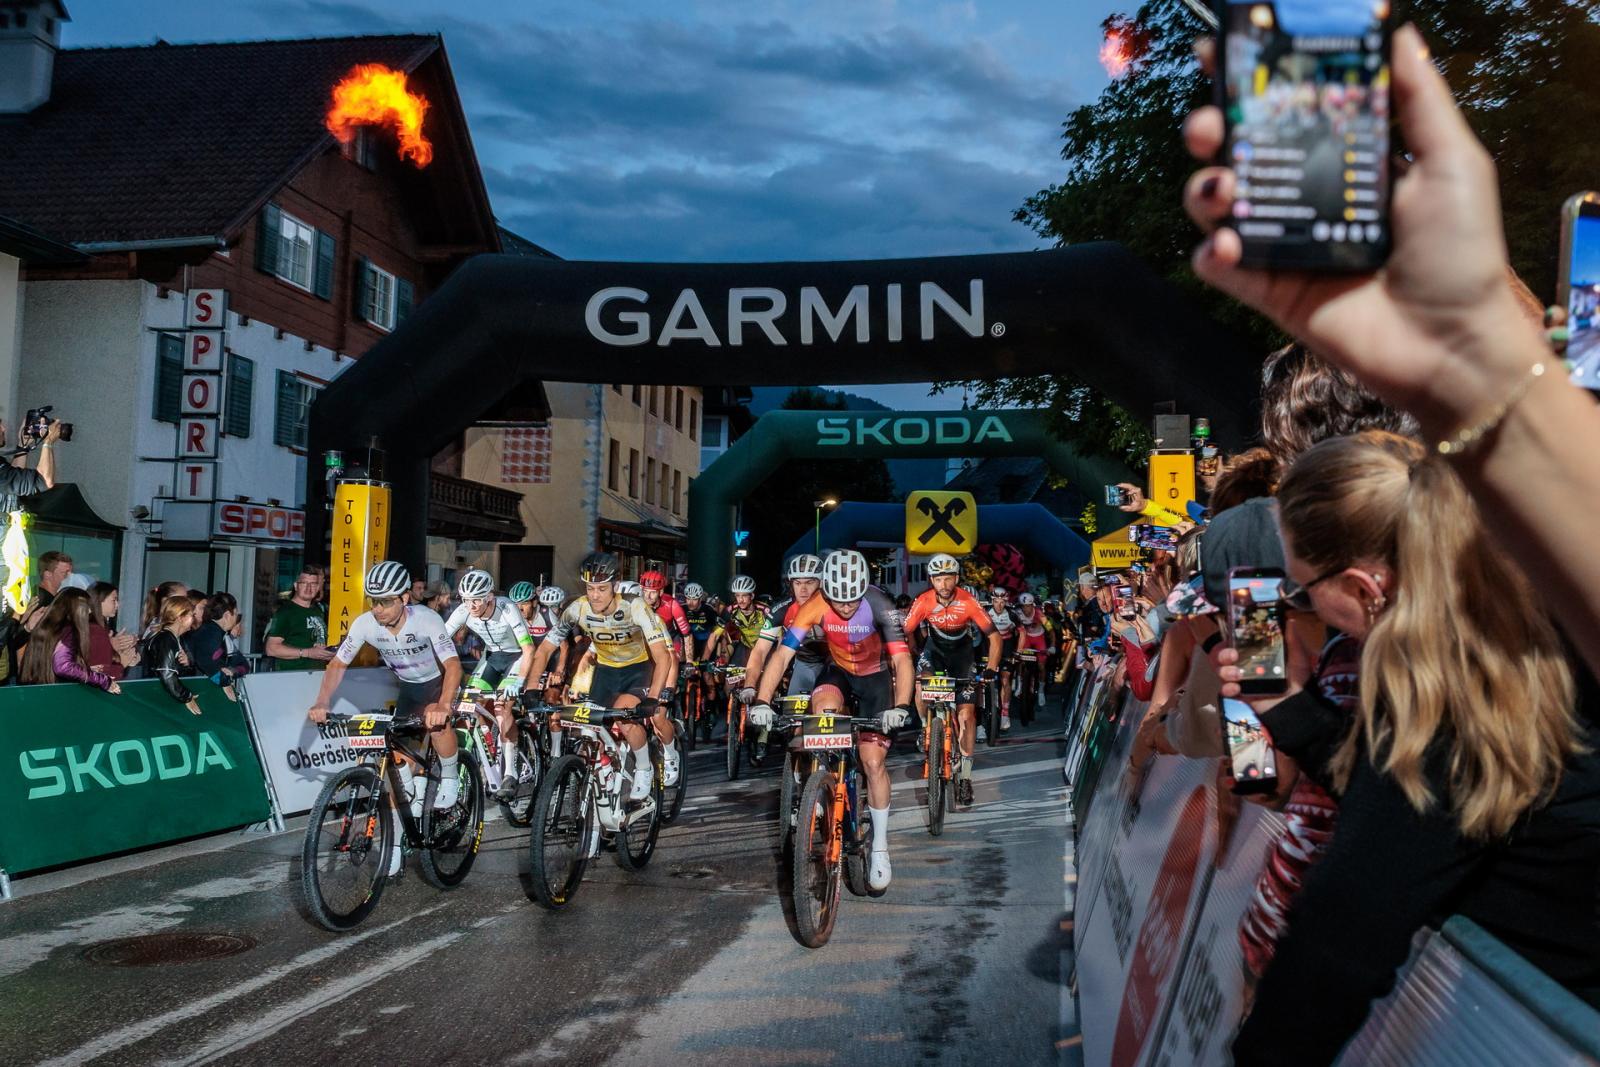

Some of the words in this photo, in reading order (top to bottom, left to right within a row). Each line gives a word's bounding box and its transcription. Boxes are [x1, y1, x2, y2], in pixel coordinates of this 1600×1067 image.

[186, 292, 212, 496] SPORT
[816, 416, 1013, 446] SKODA
[220, 504, 305, 538] SPOR
[1099, 548, 1140, 559] www.tr
[343, 538, 351, 592] HELL
[929, 679, 947, 687] A14
[574, 707, 591, 719] A2
[358, 720, 376, 730] A3
[818, 716, 834, 727] A1
[350, 738, 385, 747] MAXXIS
[805, 736, 851, 748] MAXXIS
[286, 744, 381, 771] Oberöster
[19, 732, 233, 800] SKODA
